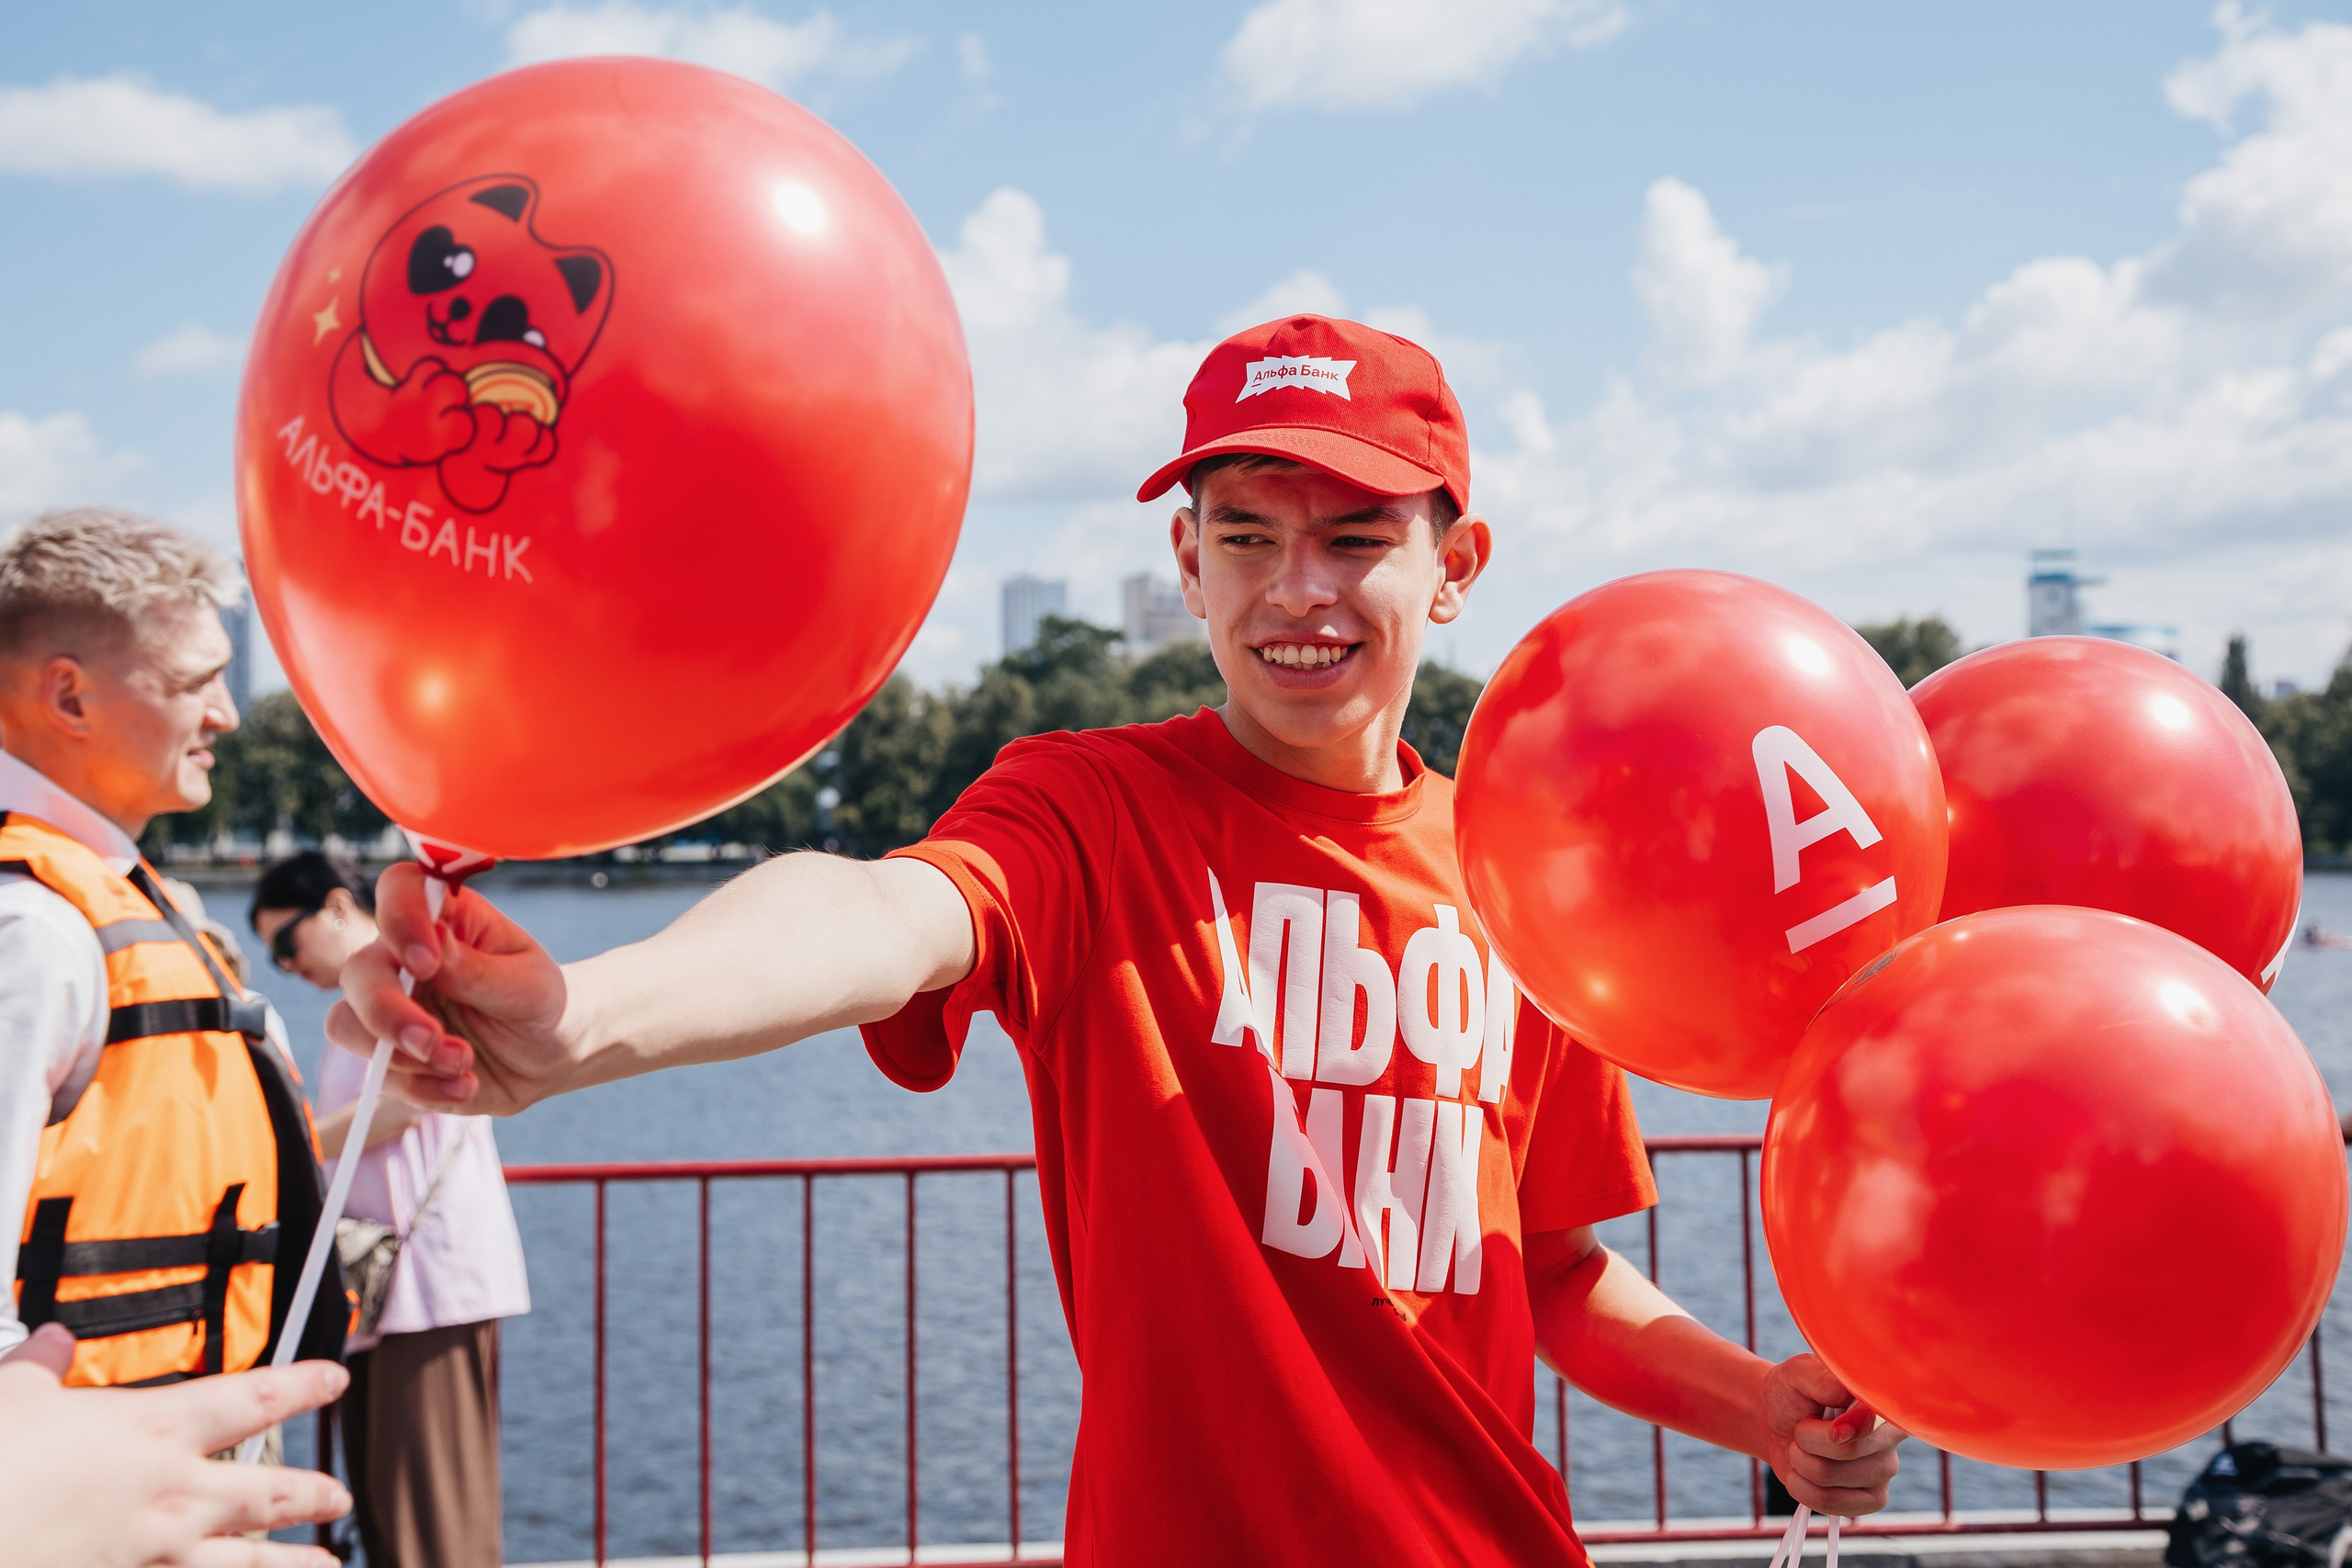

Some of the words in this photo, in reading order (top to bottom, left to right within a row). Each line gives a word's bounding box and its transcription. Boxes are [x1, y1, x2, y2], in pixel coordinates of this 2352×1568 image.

[1252, 364, 1297, 383] Альфа
[1300, 364, 1339, 381] Банк
[277, 415, 534, 584] АЛЬФА-БАНК
